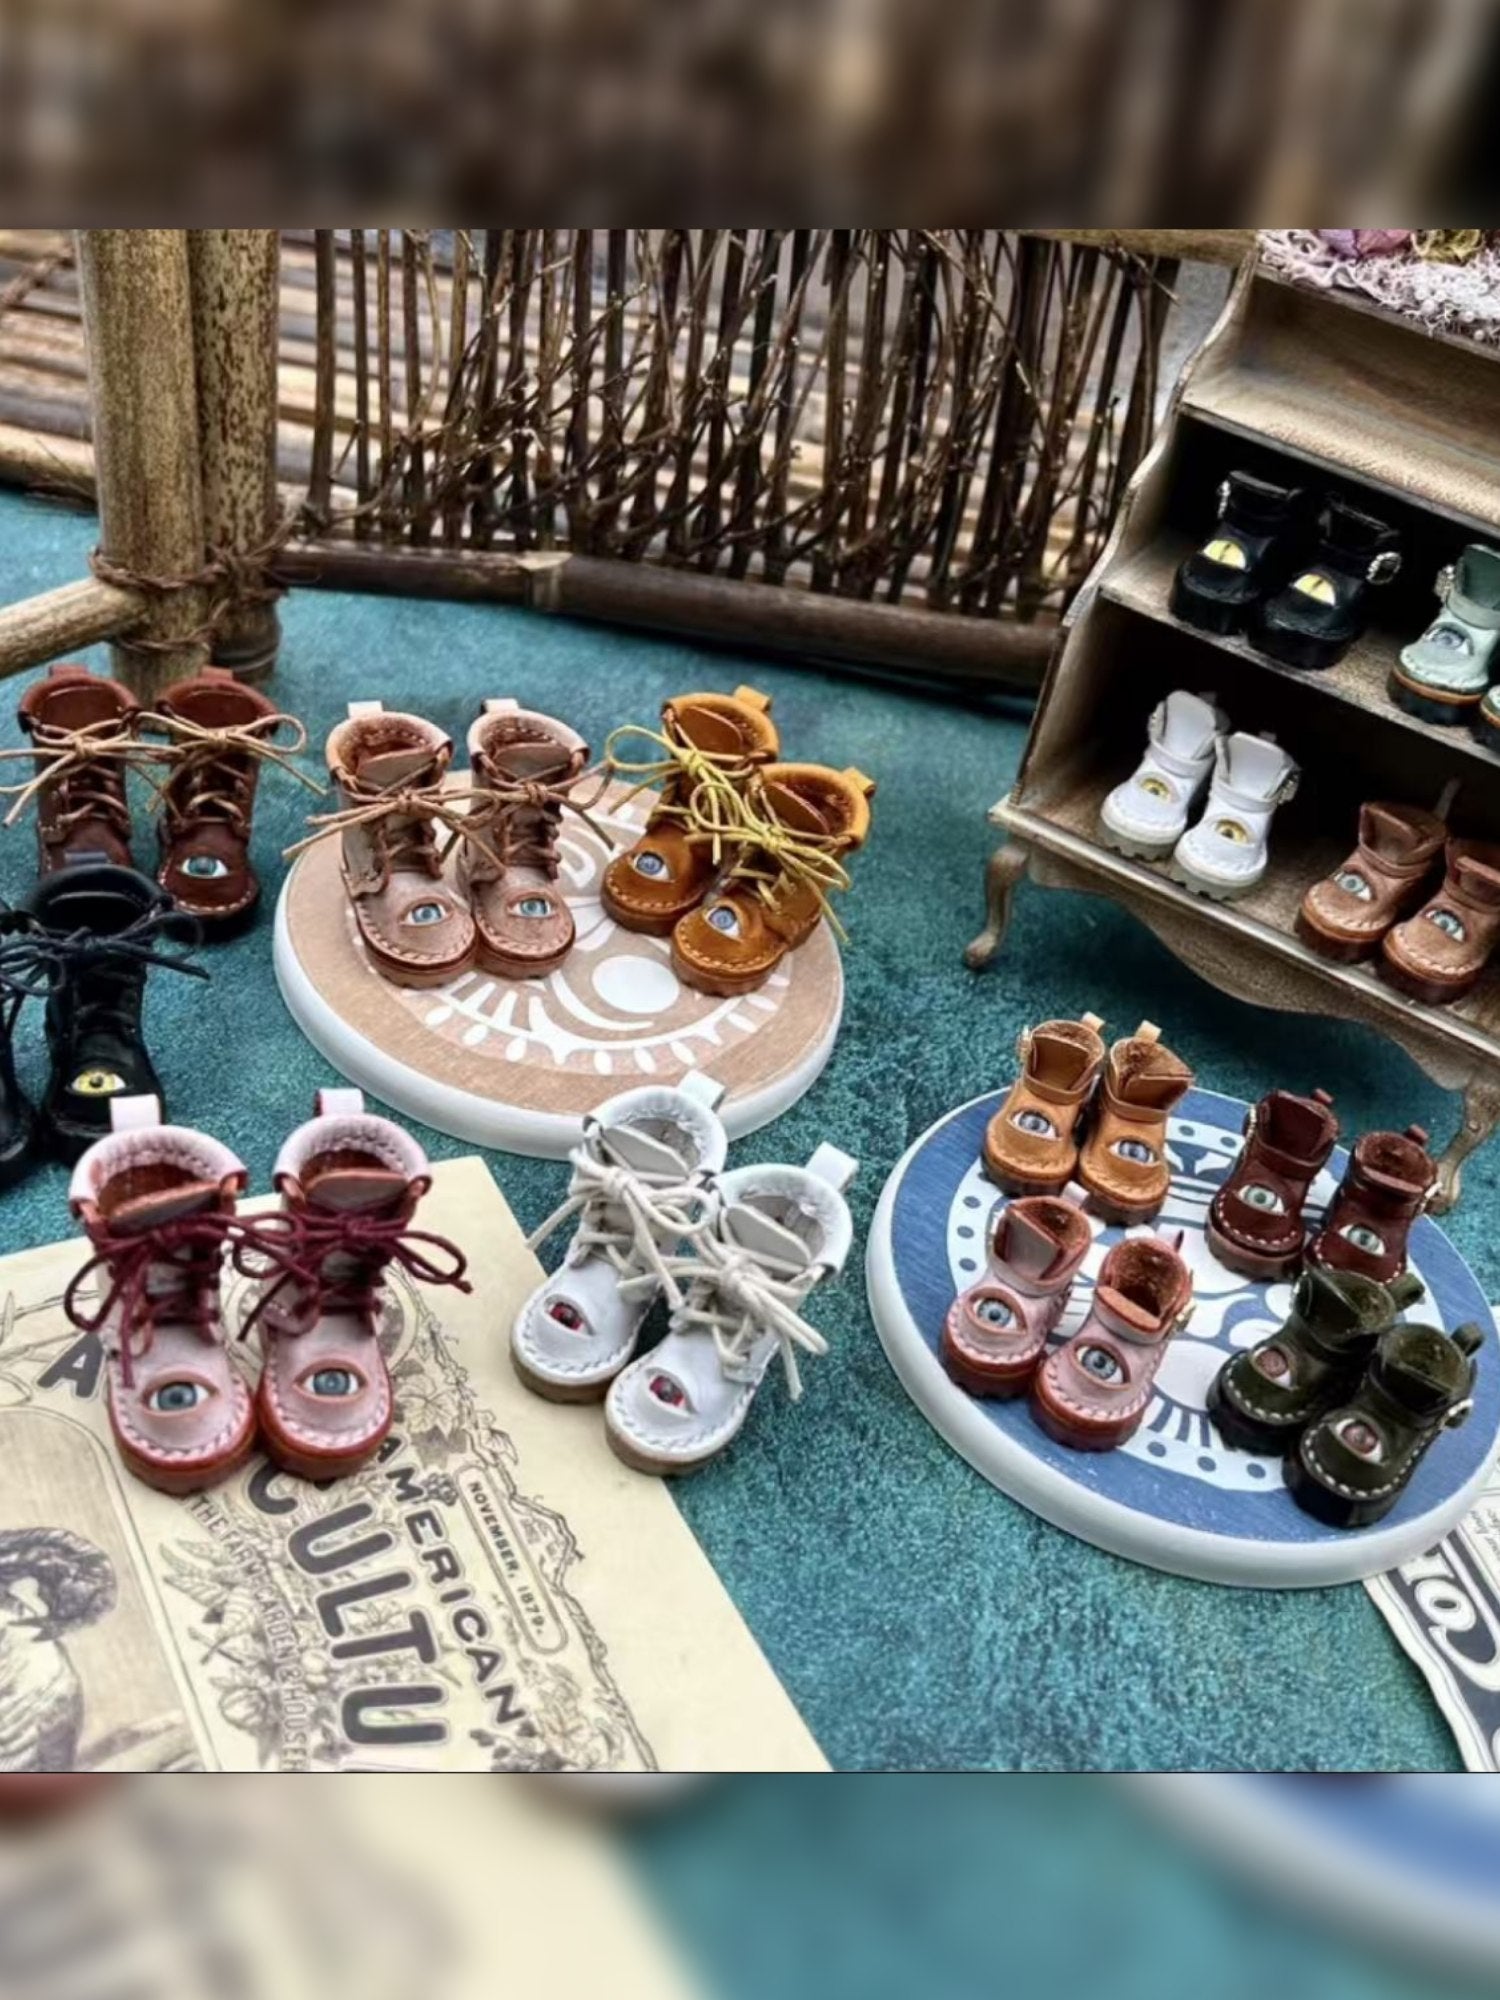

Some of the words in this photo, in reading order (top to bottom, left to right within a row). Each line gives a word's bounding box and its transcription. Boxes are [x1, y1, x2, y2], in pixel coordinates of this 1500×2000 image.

[190, 1496, 229, 1533] THE
[254, 1585, 300, 1660] GARDEN
[280, 1666, 301, 1684] &
[377, 1436, 526, 1724] AMERICAN
[467, 1480, 520, 1578] NOVEMBER,
